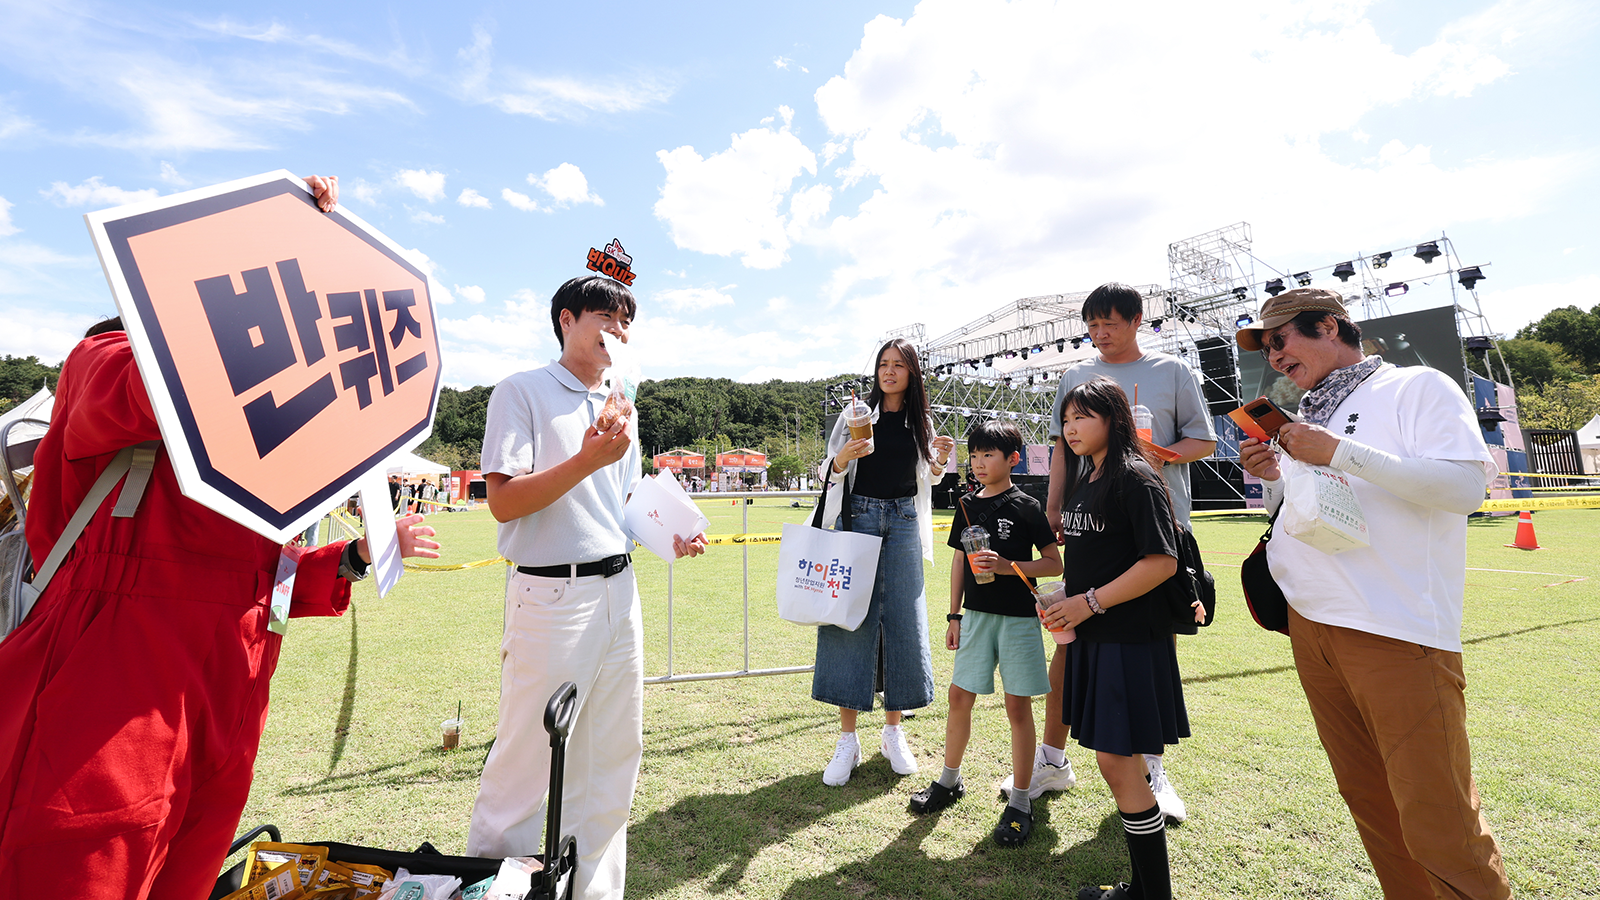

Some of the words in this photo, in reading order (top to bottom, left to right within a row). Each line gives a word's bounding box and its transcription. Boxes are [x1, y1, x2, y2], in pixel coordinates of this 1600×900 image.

[606, 246, 616, 256] SK
[586, 247, 637, 287] 반Quiz
[194, 257, 428, 460] 반퀴즈
[647, 511, 654, 519] SK
[275, 580, 291, 597] STAFF
